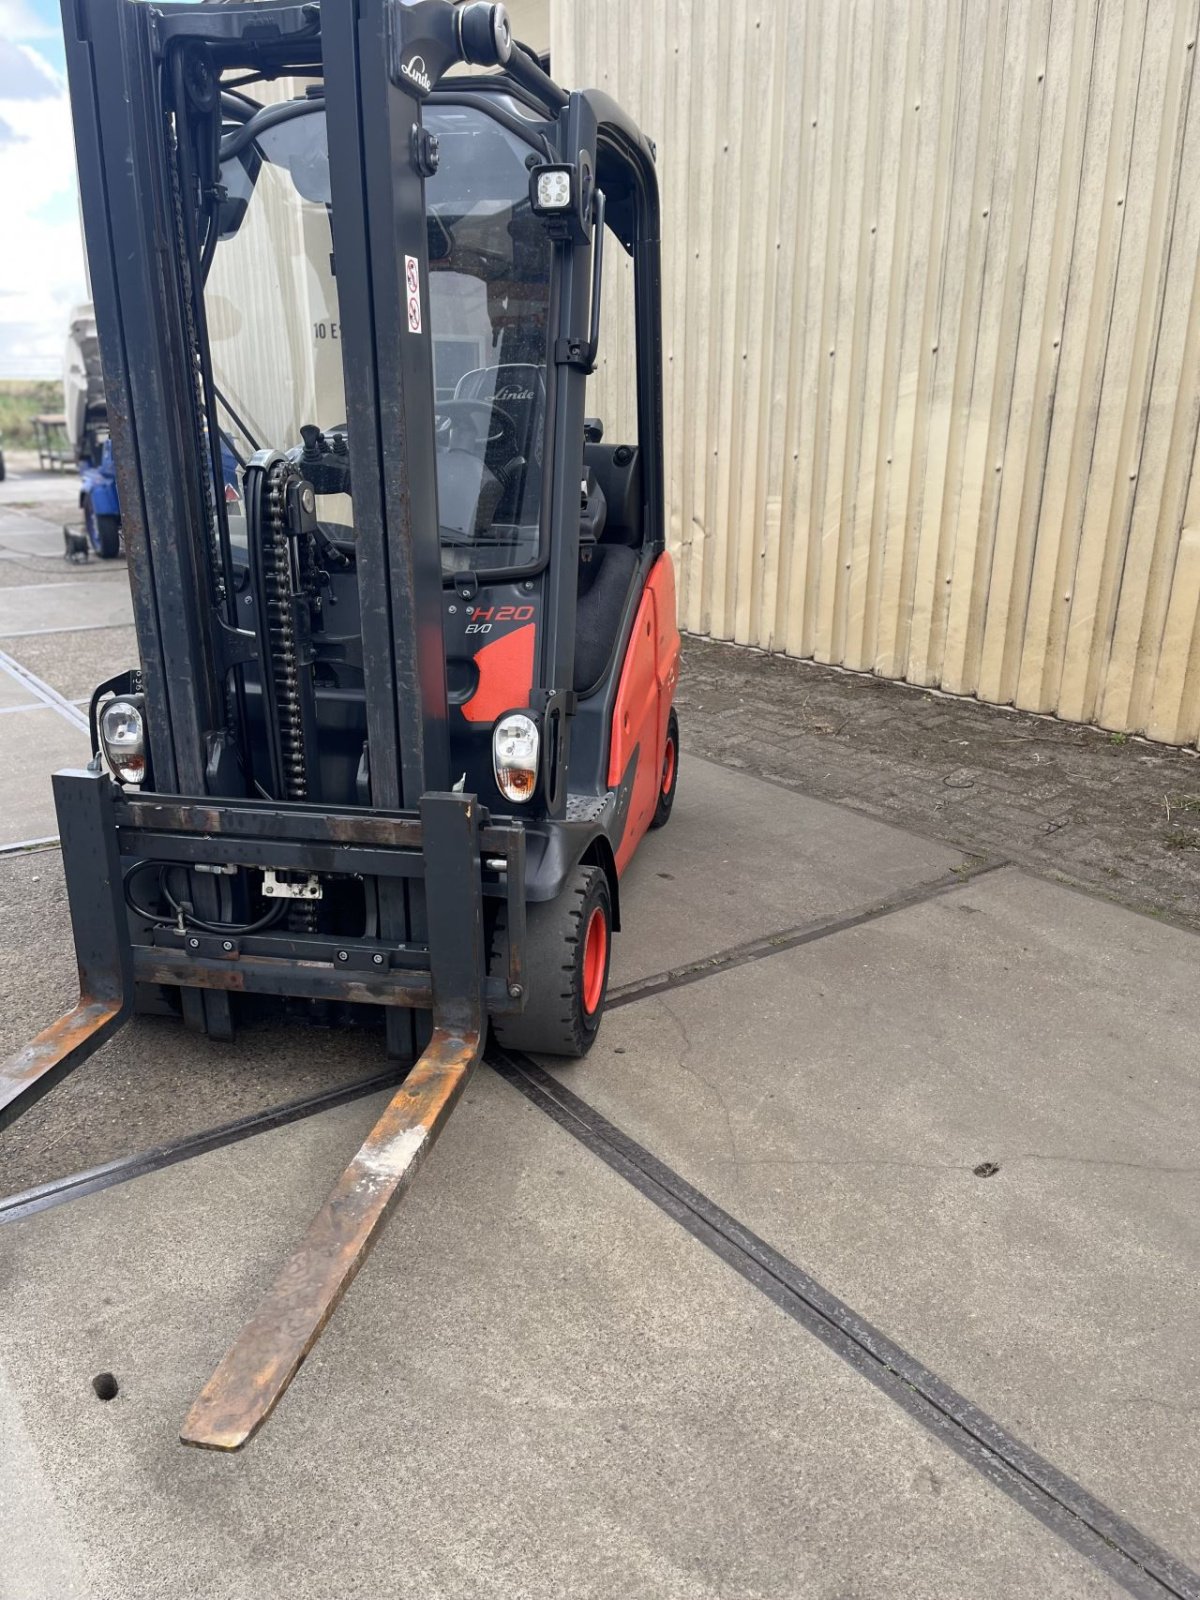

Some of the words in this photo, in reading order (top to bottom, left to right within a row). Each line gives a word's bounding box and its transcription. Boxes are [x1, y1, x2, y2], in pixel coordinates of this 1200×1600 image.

[401, 55, 431, 92] Linde
[313, 322, 327, 339] 10
[330, 322, 341, 339] E
[484, 384, 535, 401] Linde
[464, 623, 493, 634] EVO
